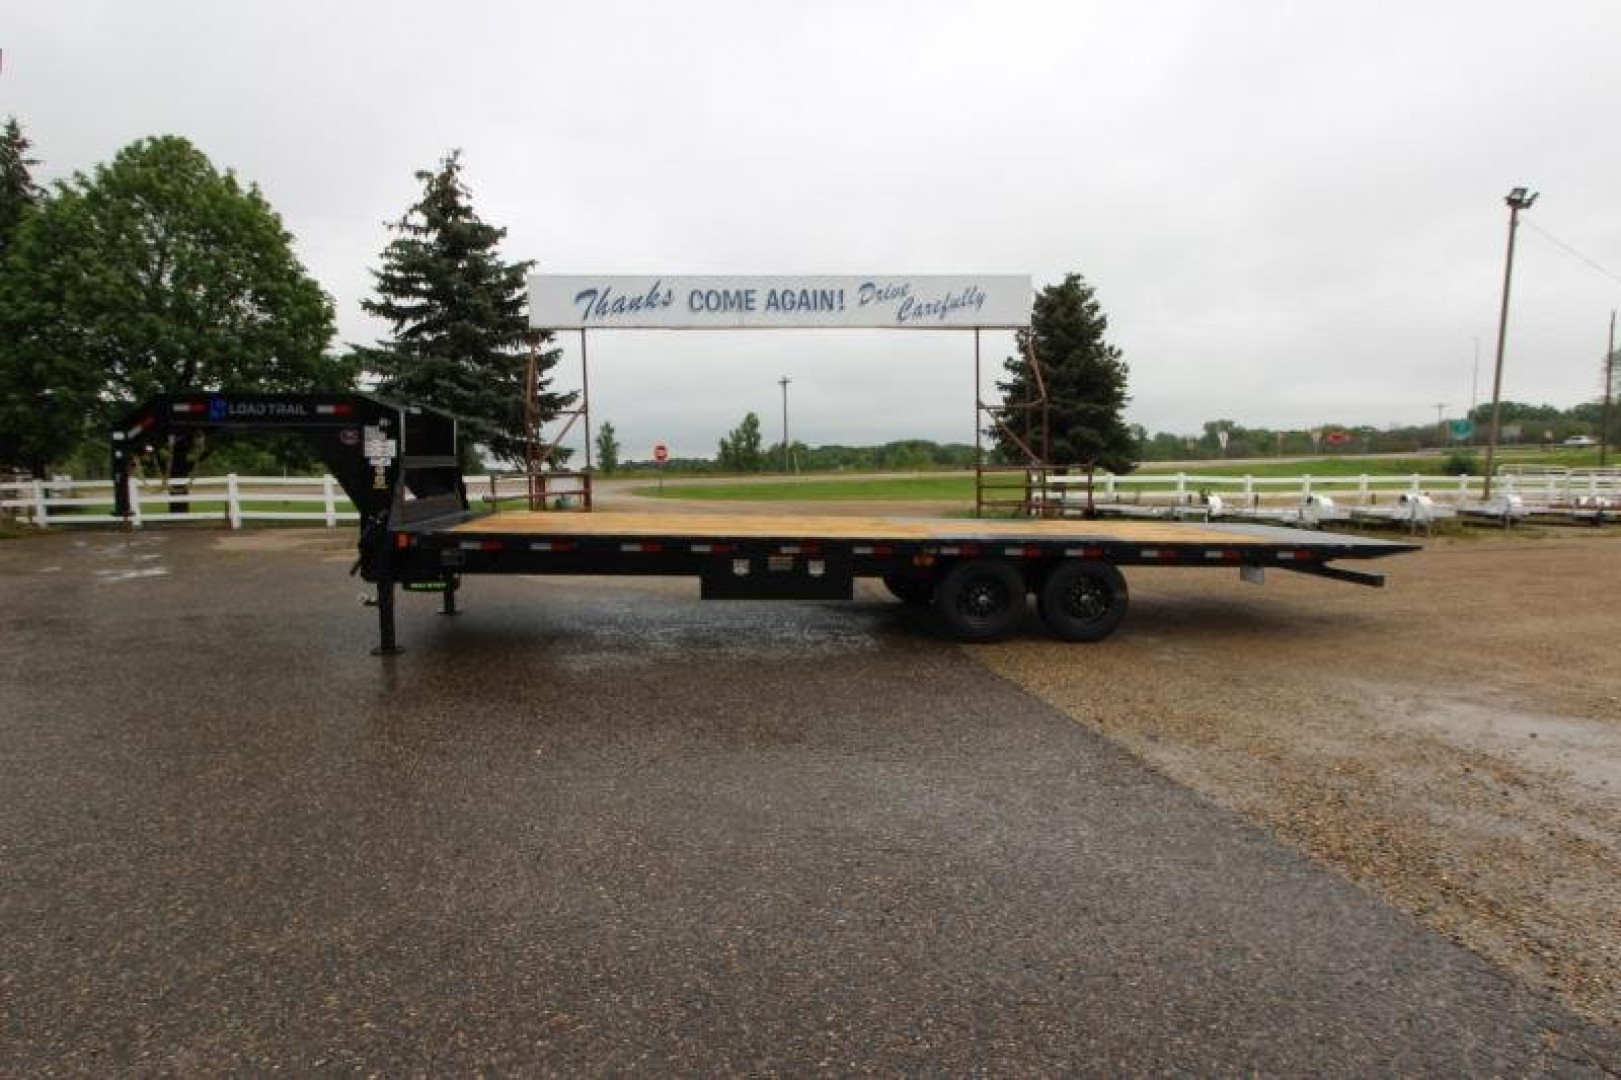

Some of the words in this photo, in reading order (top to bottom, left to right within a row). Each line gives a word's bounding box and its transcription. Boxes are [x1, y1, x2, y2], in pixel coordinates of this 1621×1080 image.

[574, 280, 673, 321] Thanks
[689, 288, 757, 312] COME
[765, 288, 845, 312] AGAIN!
[858, 281, 911, 307] Drive
[896, 285, 987, 322] Carefully
[228, 403, 266, 415] LOAD
[268, 403, 308, 416] TRAIL
